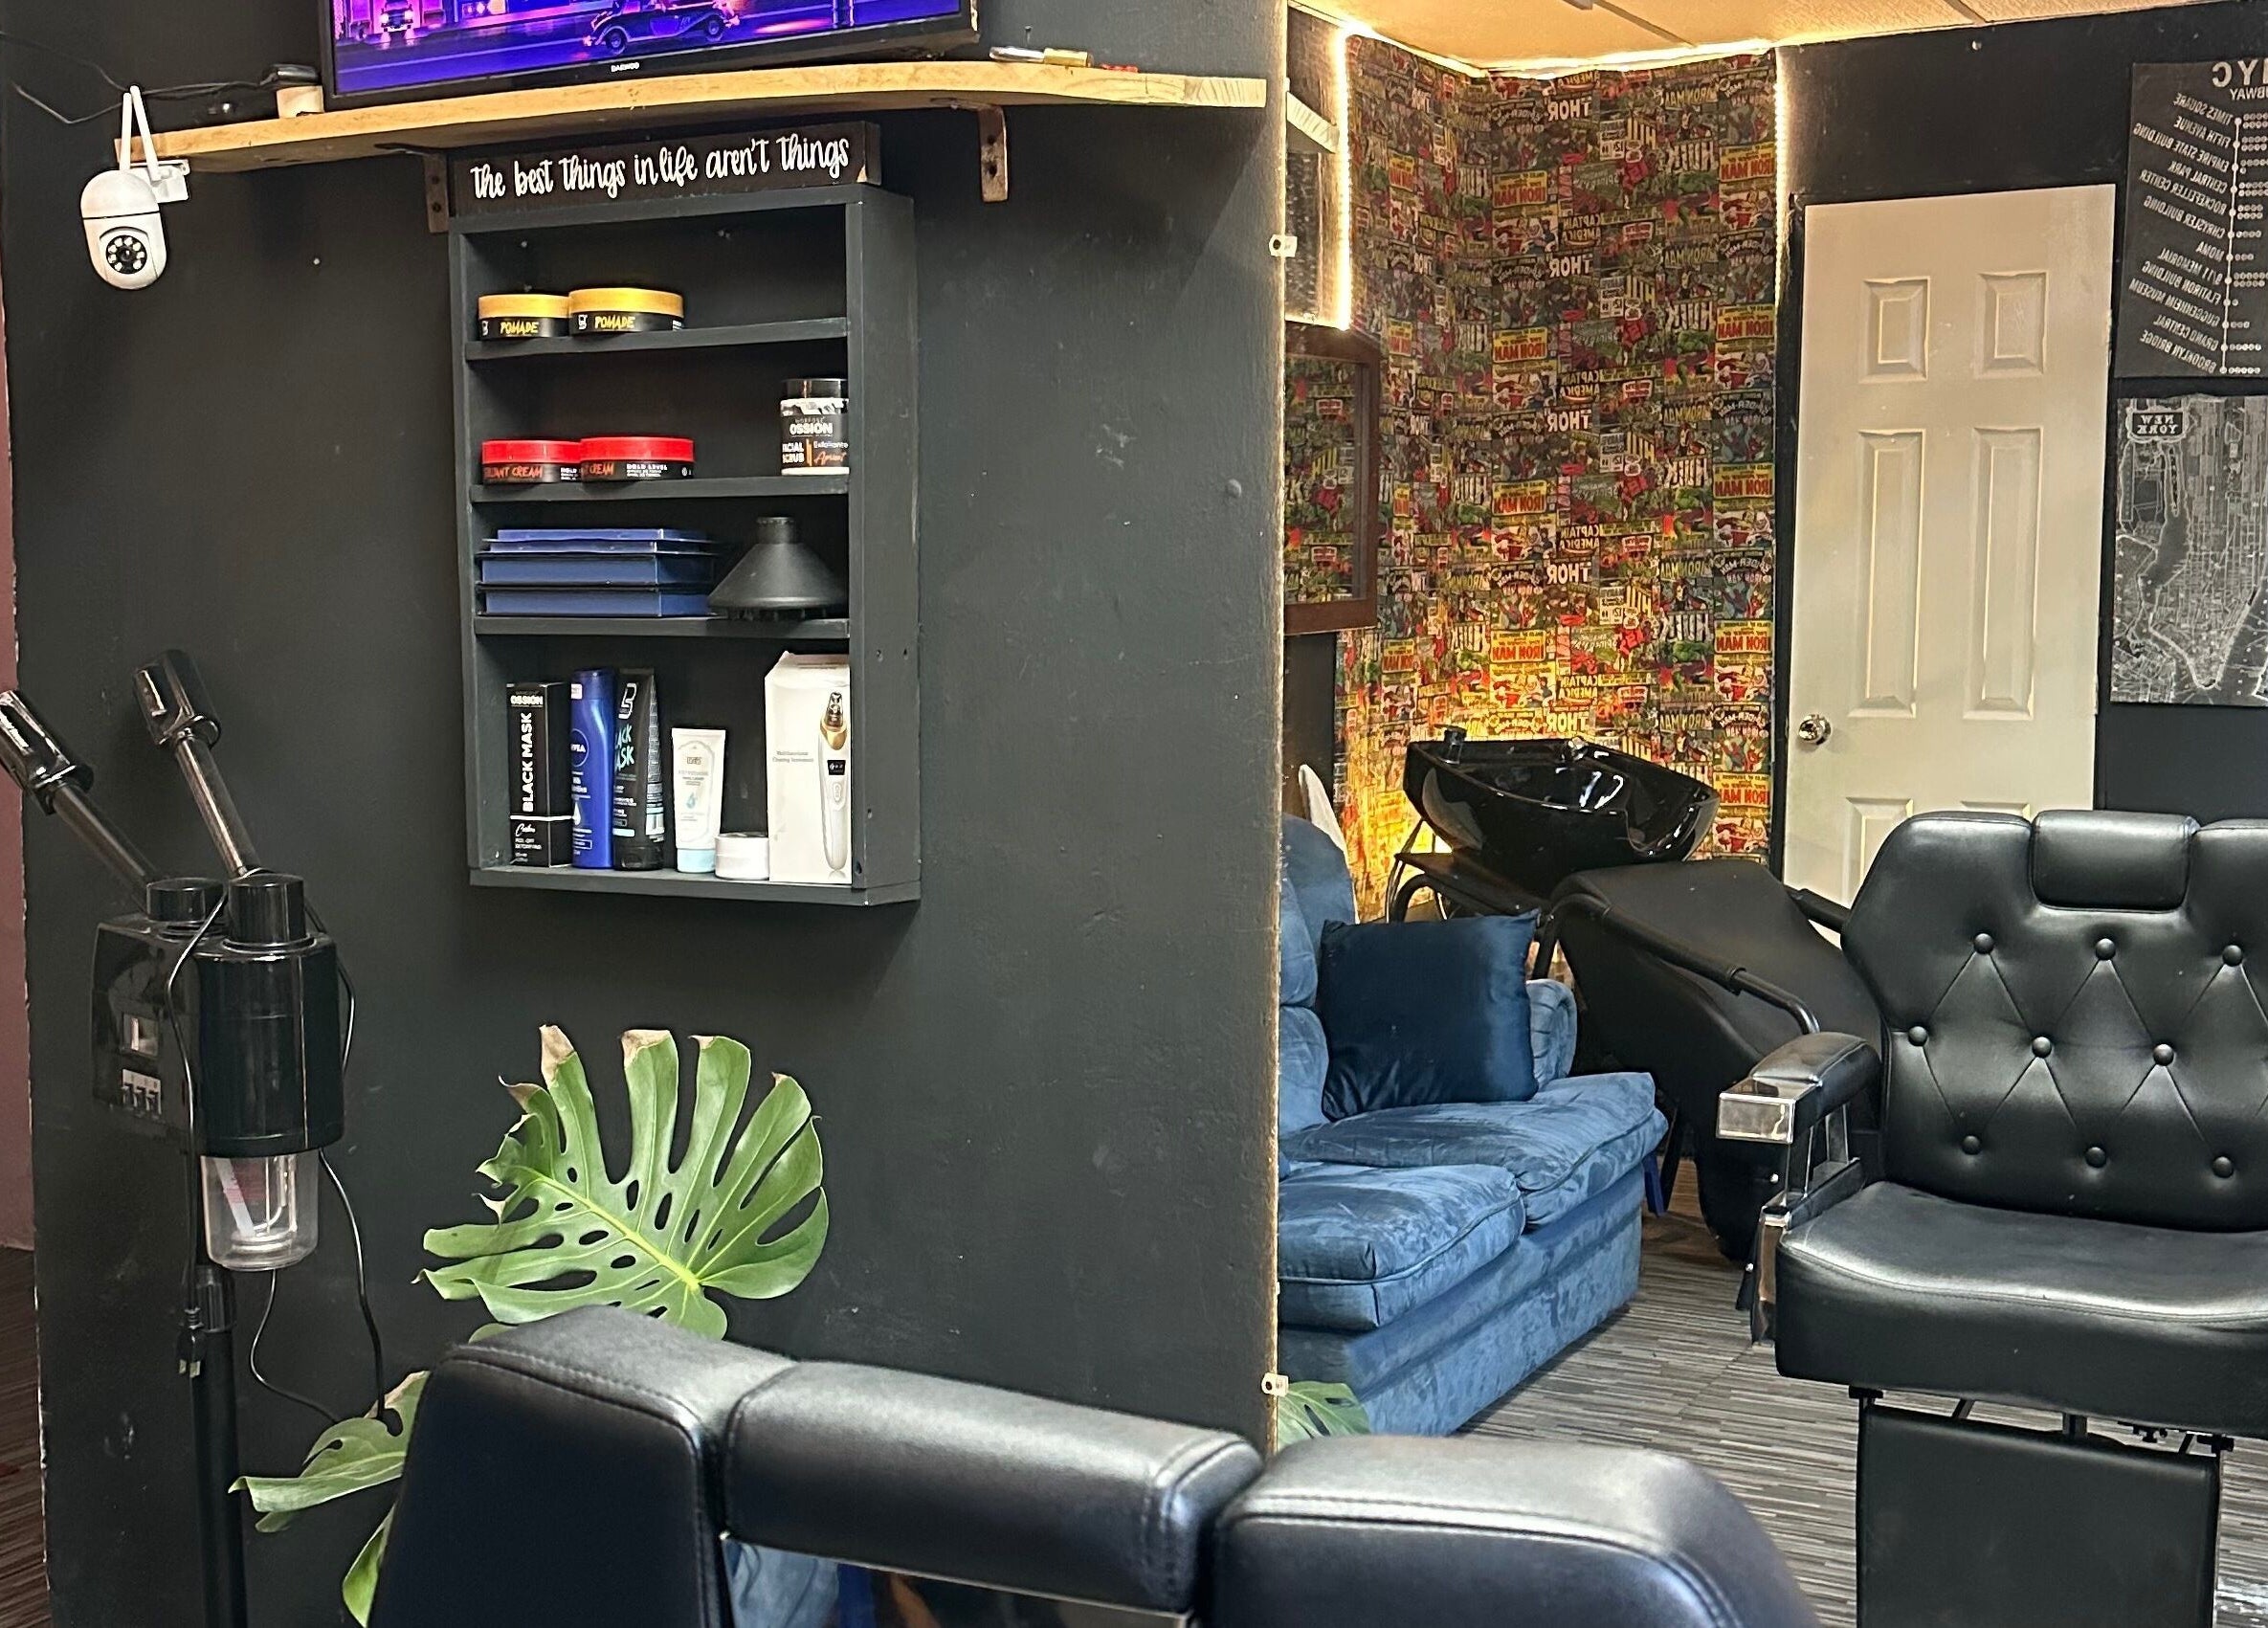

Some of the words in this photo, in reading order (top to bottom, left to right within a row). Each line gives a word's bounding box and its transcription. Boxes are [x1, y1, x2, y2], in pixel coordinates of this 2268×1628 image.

[611, 62, 640, 73] DAEWOO
[514, 159, 554, 197] best
[558, 154, 626, 199] things
[634, 154, 658, 186] in
[658, 145, 699, 188] life
[705, 138, 770, 179] aren't
[775, 133, 850, 179] things
[500, 320, 540, 334] POMADE
[594, 314, 635, 328] POMADE
[789, 422, 834, 435] OSSION
[520, 711, 533, 758] MASK
[522, 760, 534, 813] BLACK
